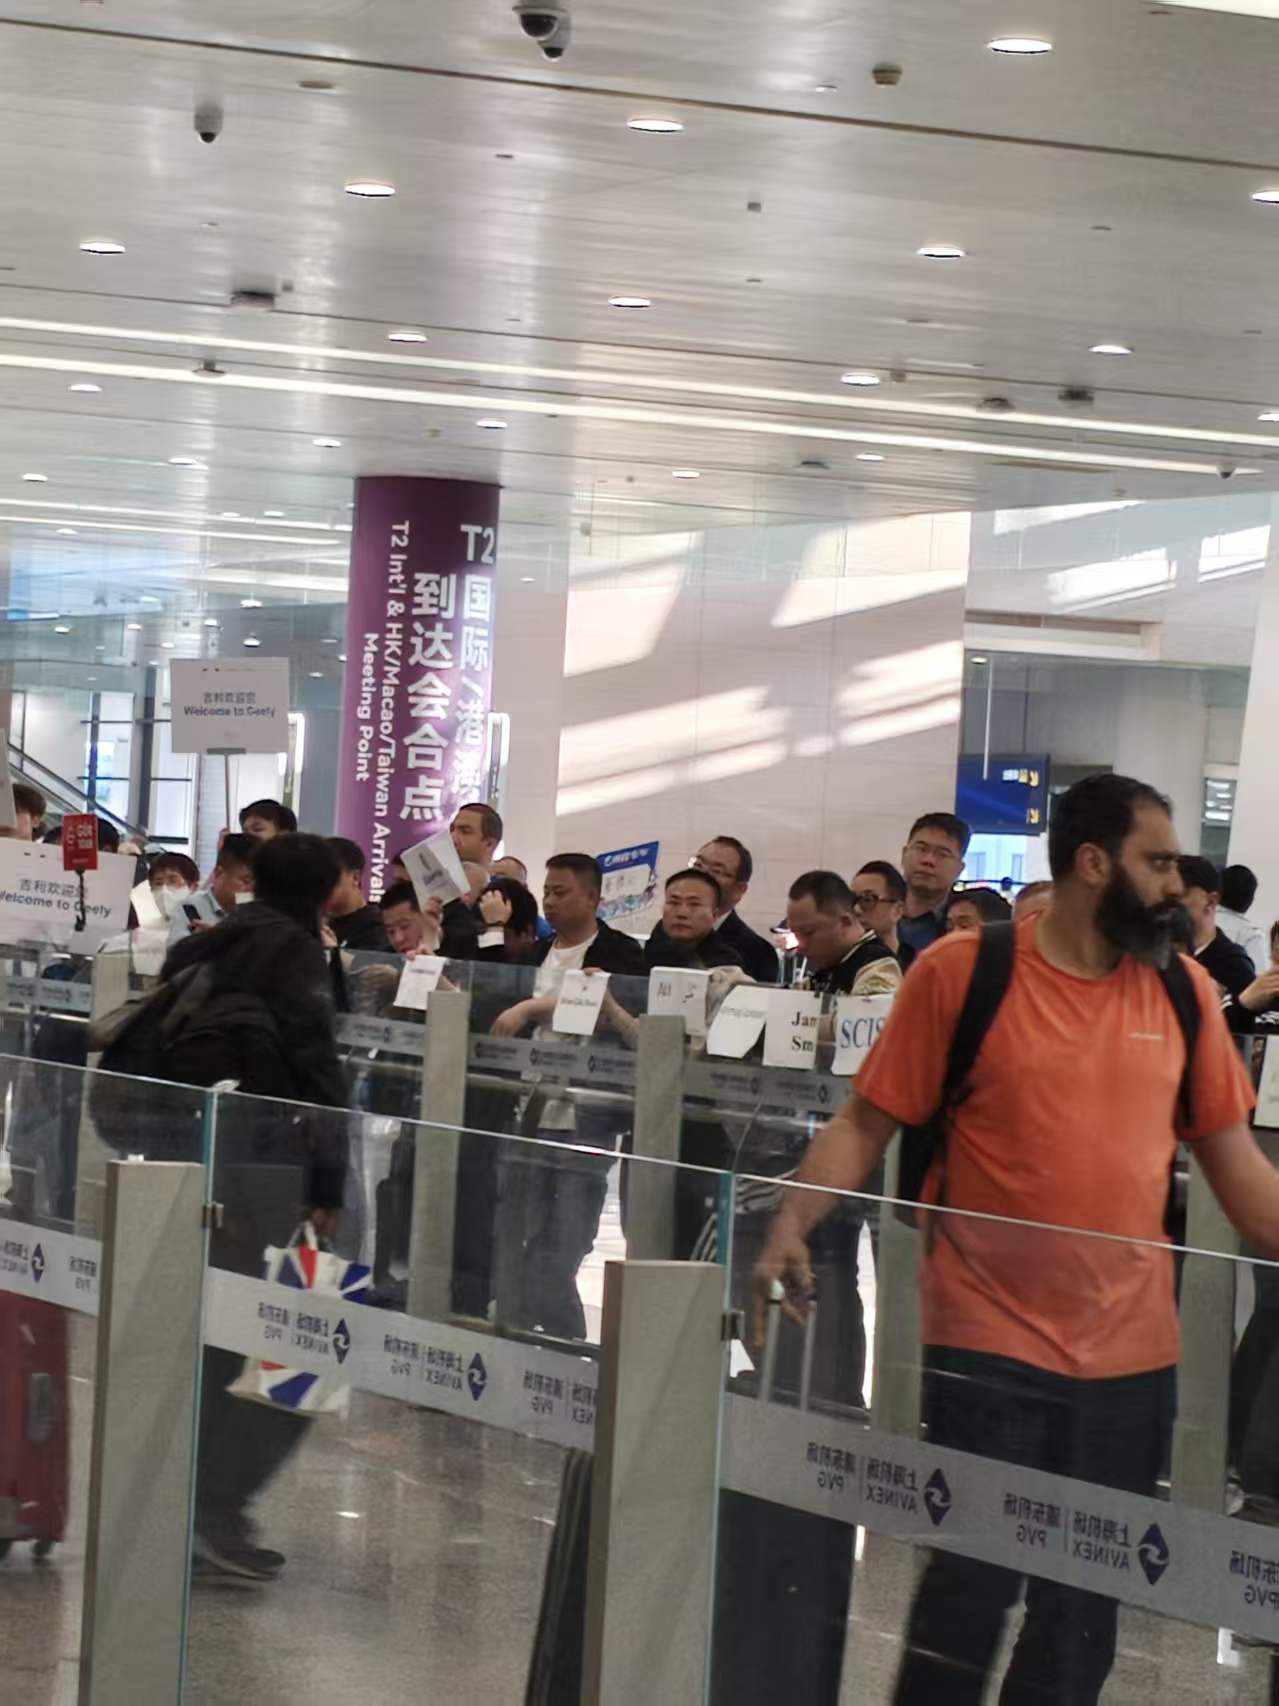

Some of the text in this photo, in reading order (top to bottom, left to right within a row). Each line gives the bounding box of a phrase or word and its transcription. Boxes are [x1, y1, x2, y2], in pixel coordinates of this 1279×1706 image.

[184, 706, 231, 717] Welcome
[233, 706, 245, 717] to
[356, 632, 380, 782] Meeting Point
[368, 519, 410, 903] T2 Int'l & HK/Macao/Taiwan Arrivals
[399, 572, 457, 821] 到达会合点
[57, 900, 70, 911] to
